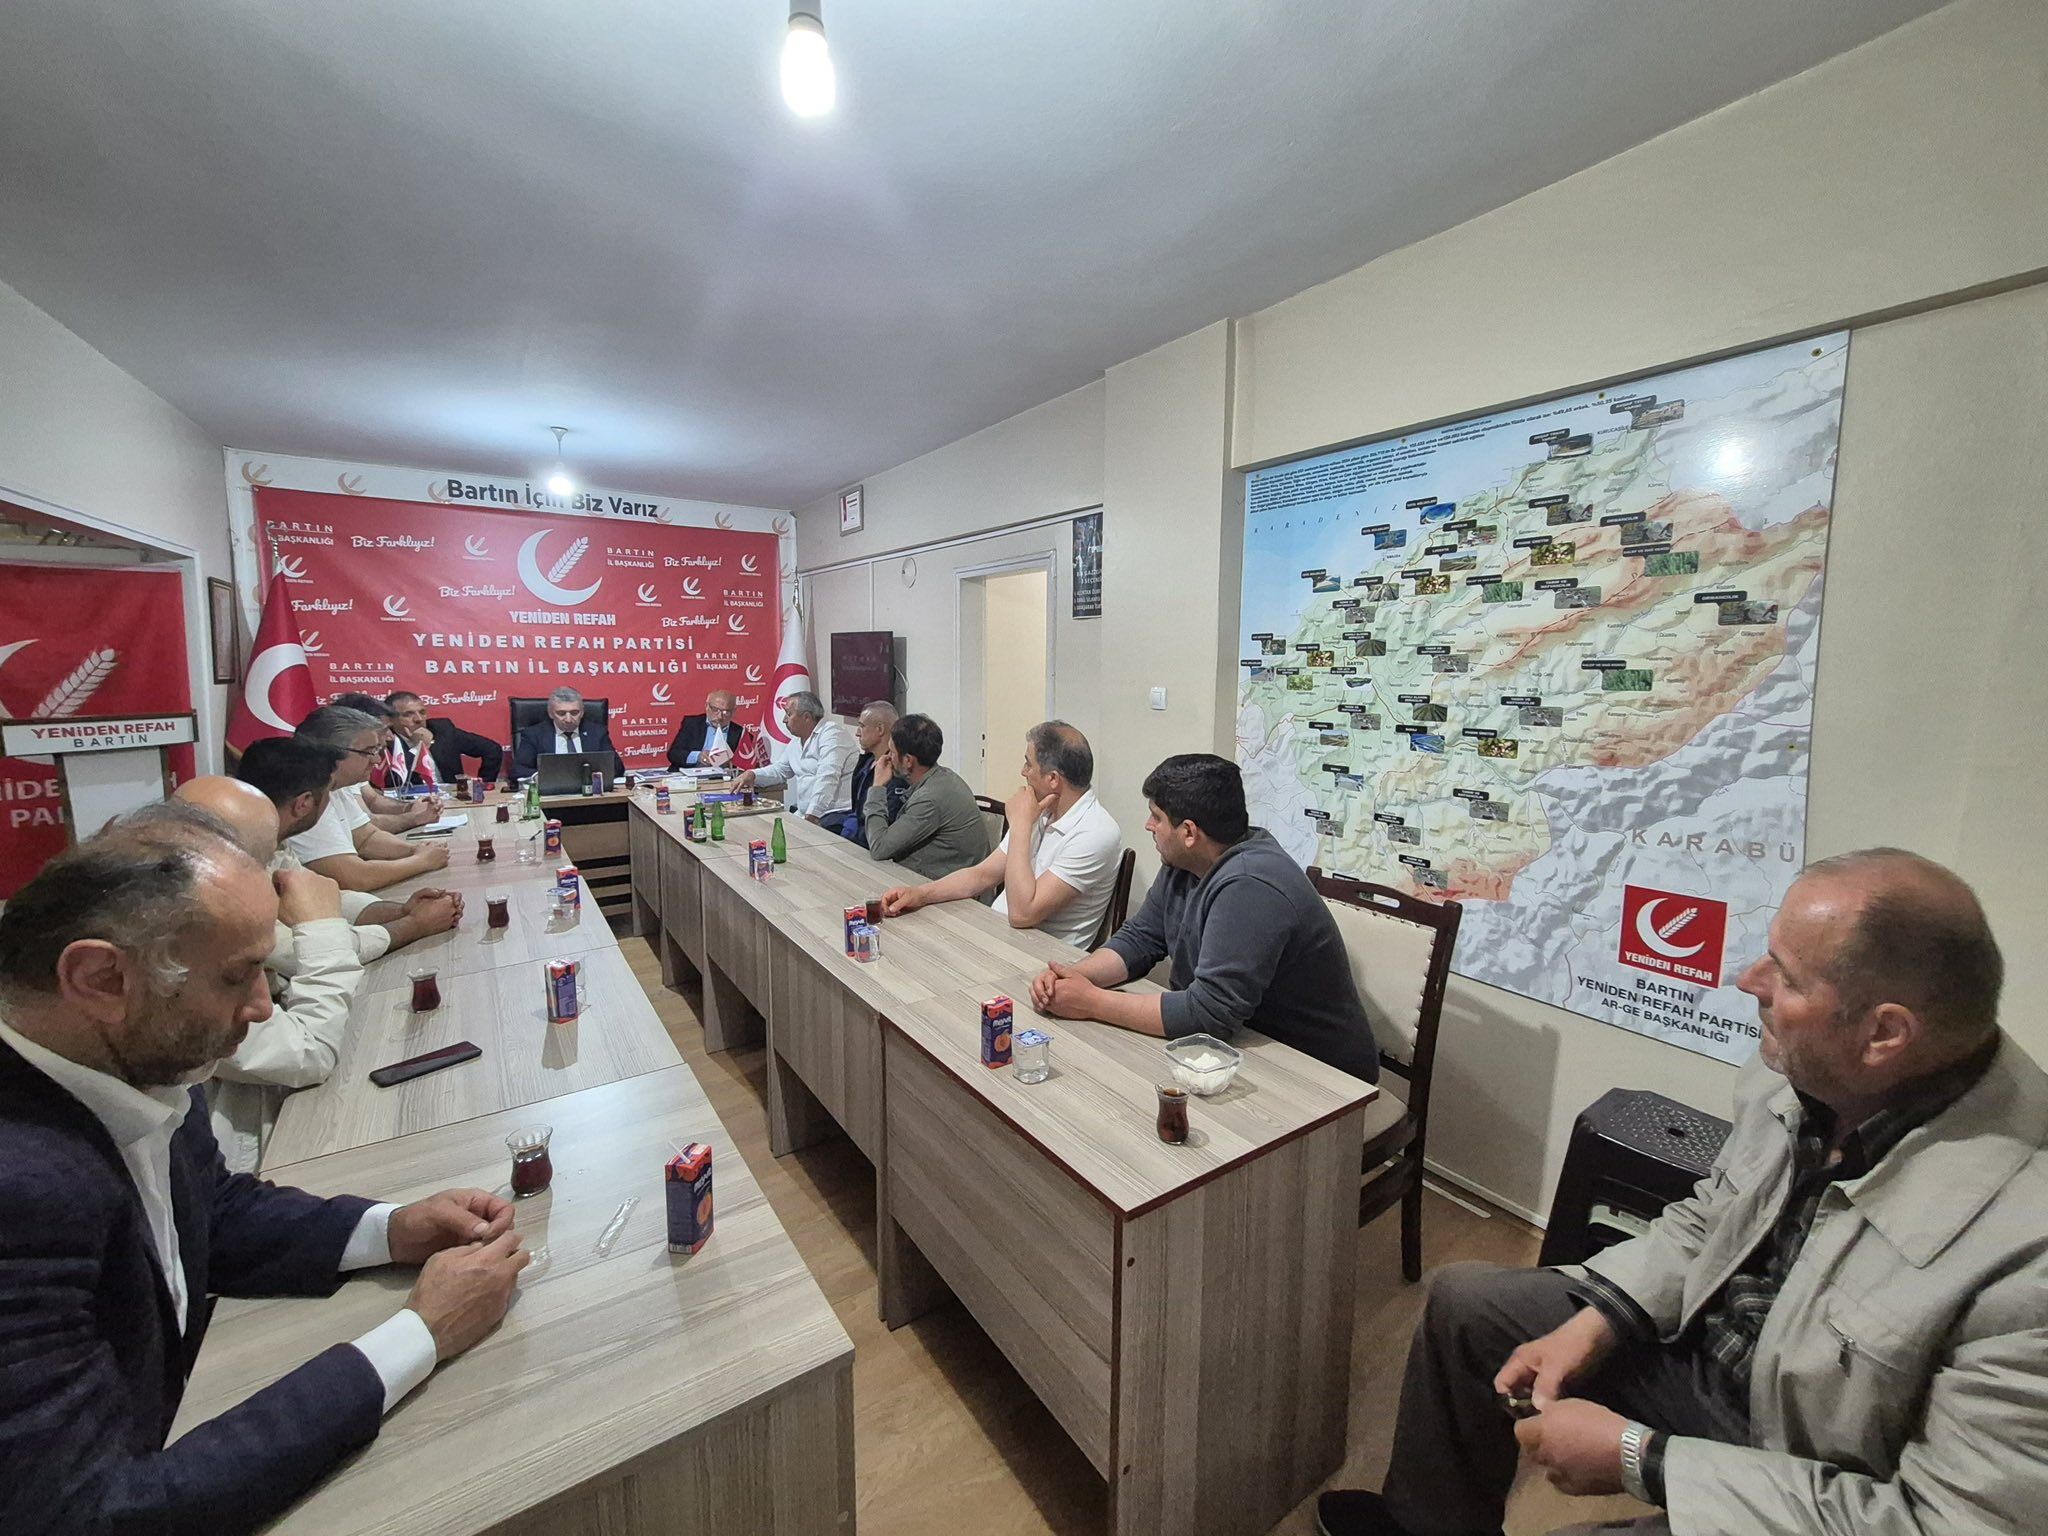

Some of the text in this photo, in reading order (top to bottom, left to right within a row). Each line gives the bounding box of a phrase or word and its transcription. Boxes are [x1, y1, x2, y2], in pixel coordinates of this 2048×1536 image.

[447, 479, 658, 518] Bartın İçin Biz Varız
[352, 536, 435, 552] Biz Farklıyız!
[607, 547, 655, 557] BARTIN
[664, 556, 722, 570] Biz Farklıyız!
[439, 585, 515, 600] Biz Farklıyız!
[723, 589, 764, 598] BARTIN
[291, 599, 353, 615] Farklıyız!
[509, 609, 616, 625] YENİDEN REFAH
[661, 615, 720, 629] Biz Farklıyız!
[412, 631, 693, 650] YENİDEN REFAH PARTİSİ
[696, 652, 738, 660] BARTIN
[329, 663, 394, 671] BARTIN
[425, 658, 688, 677] BARTIN İL BAŞKANLIĞI
[339, 675, 395, 685] BAŞKANLIĞI
[420, 690, 497, 707] Biz Farklıyız!
[622, 717, 668, 725] BARTIN
[31, 722, 175, 739] YENİDEN REFAH
[74, 734, 148, 748] BARTIN
[624, 742, 669, 758] Farklıyız!
[1624, 950, 1713, 982] YENİDEN REFAH
[1578, 975, 1637, 1004] YENİDEN
[1641, 995, 1694, 1020] REFAH
[1636, 978, 1694, 1004] BARTIN
[1601, 997, 1729, 1044] AR-GE BAŞKANLIĞI
